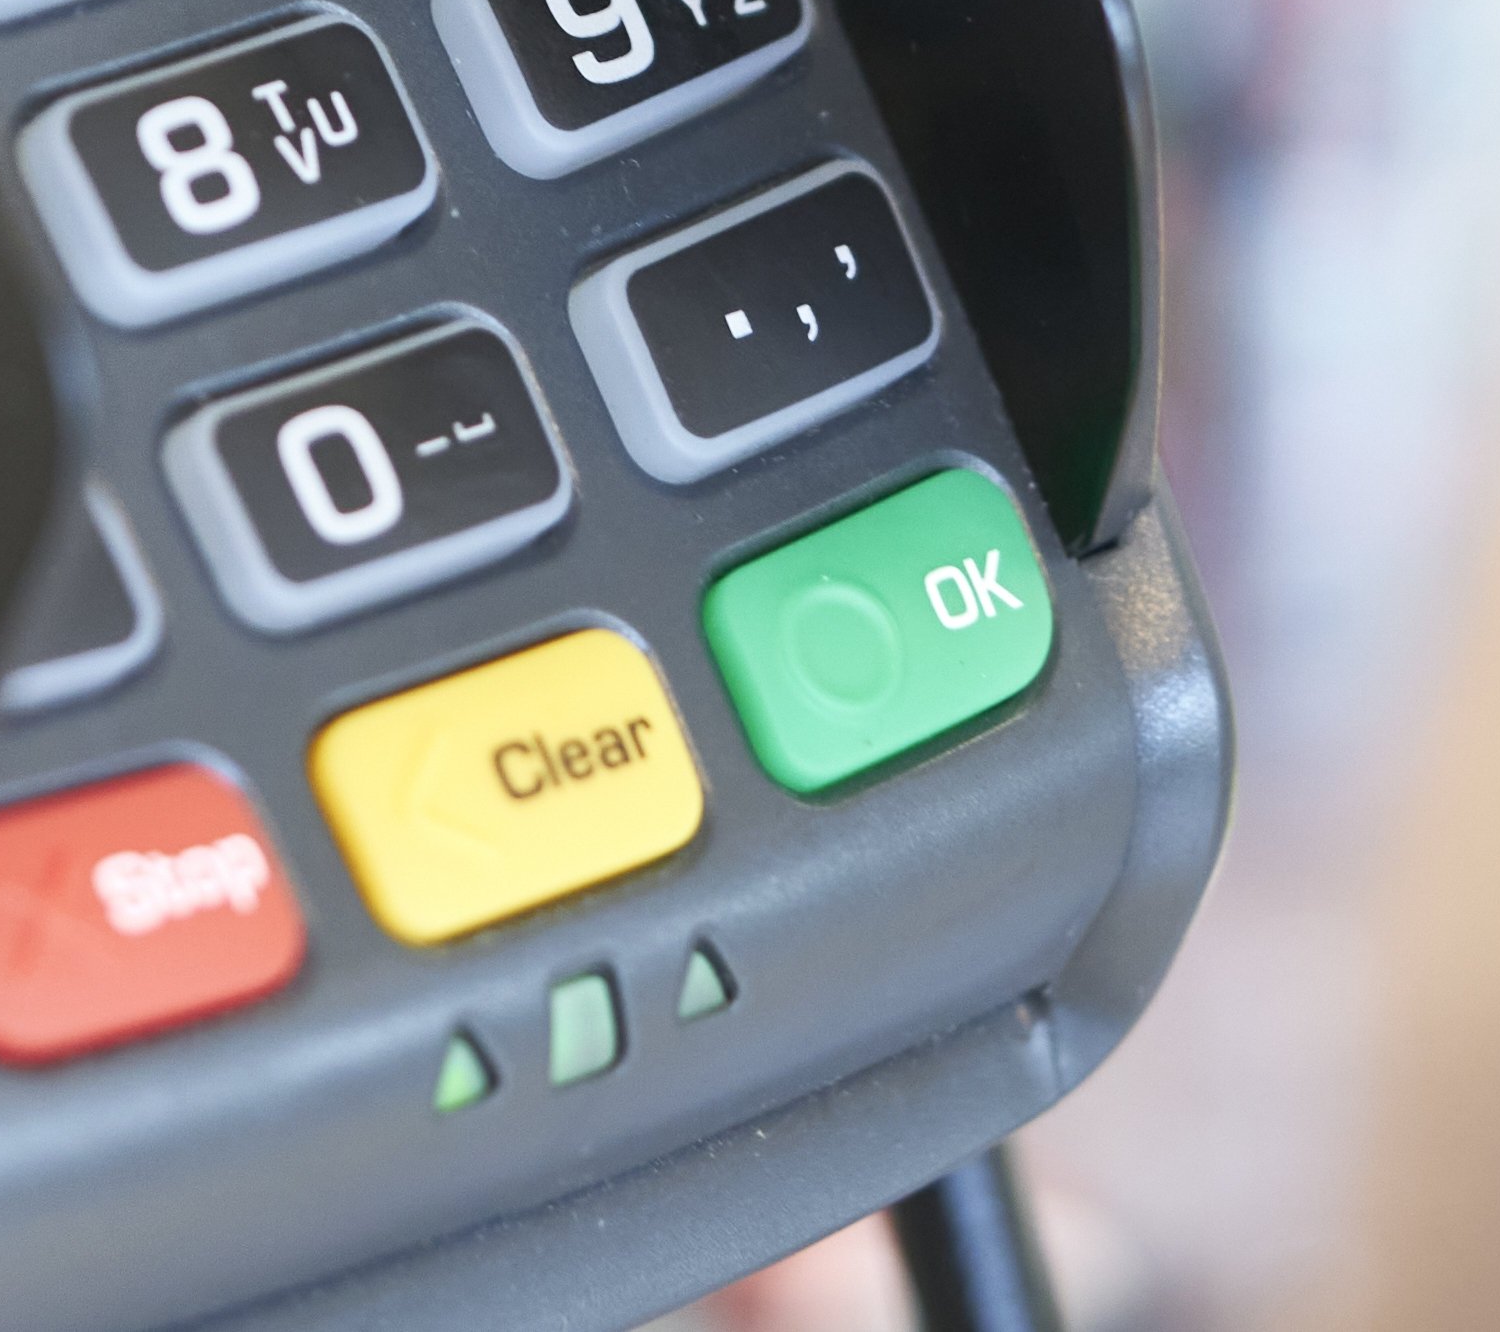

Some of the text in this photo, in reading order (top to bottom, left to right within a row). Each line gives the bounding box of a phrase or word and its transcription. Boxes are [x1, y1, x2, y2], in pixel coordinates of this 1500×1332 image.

[135, 95, 262, 234] 8
[276, 403, 403, 545] 0
[923, 548, 1024, 632] OK
[492, 709, 653, 804] Clear
[91, 833, 270, 936] Stop
